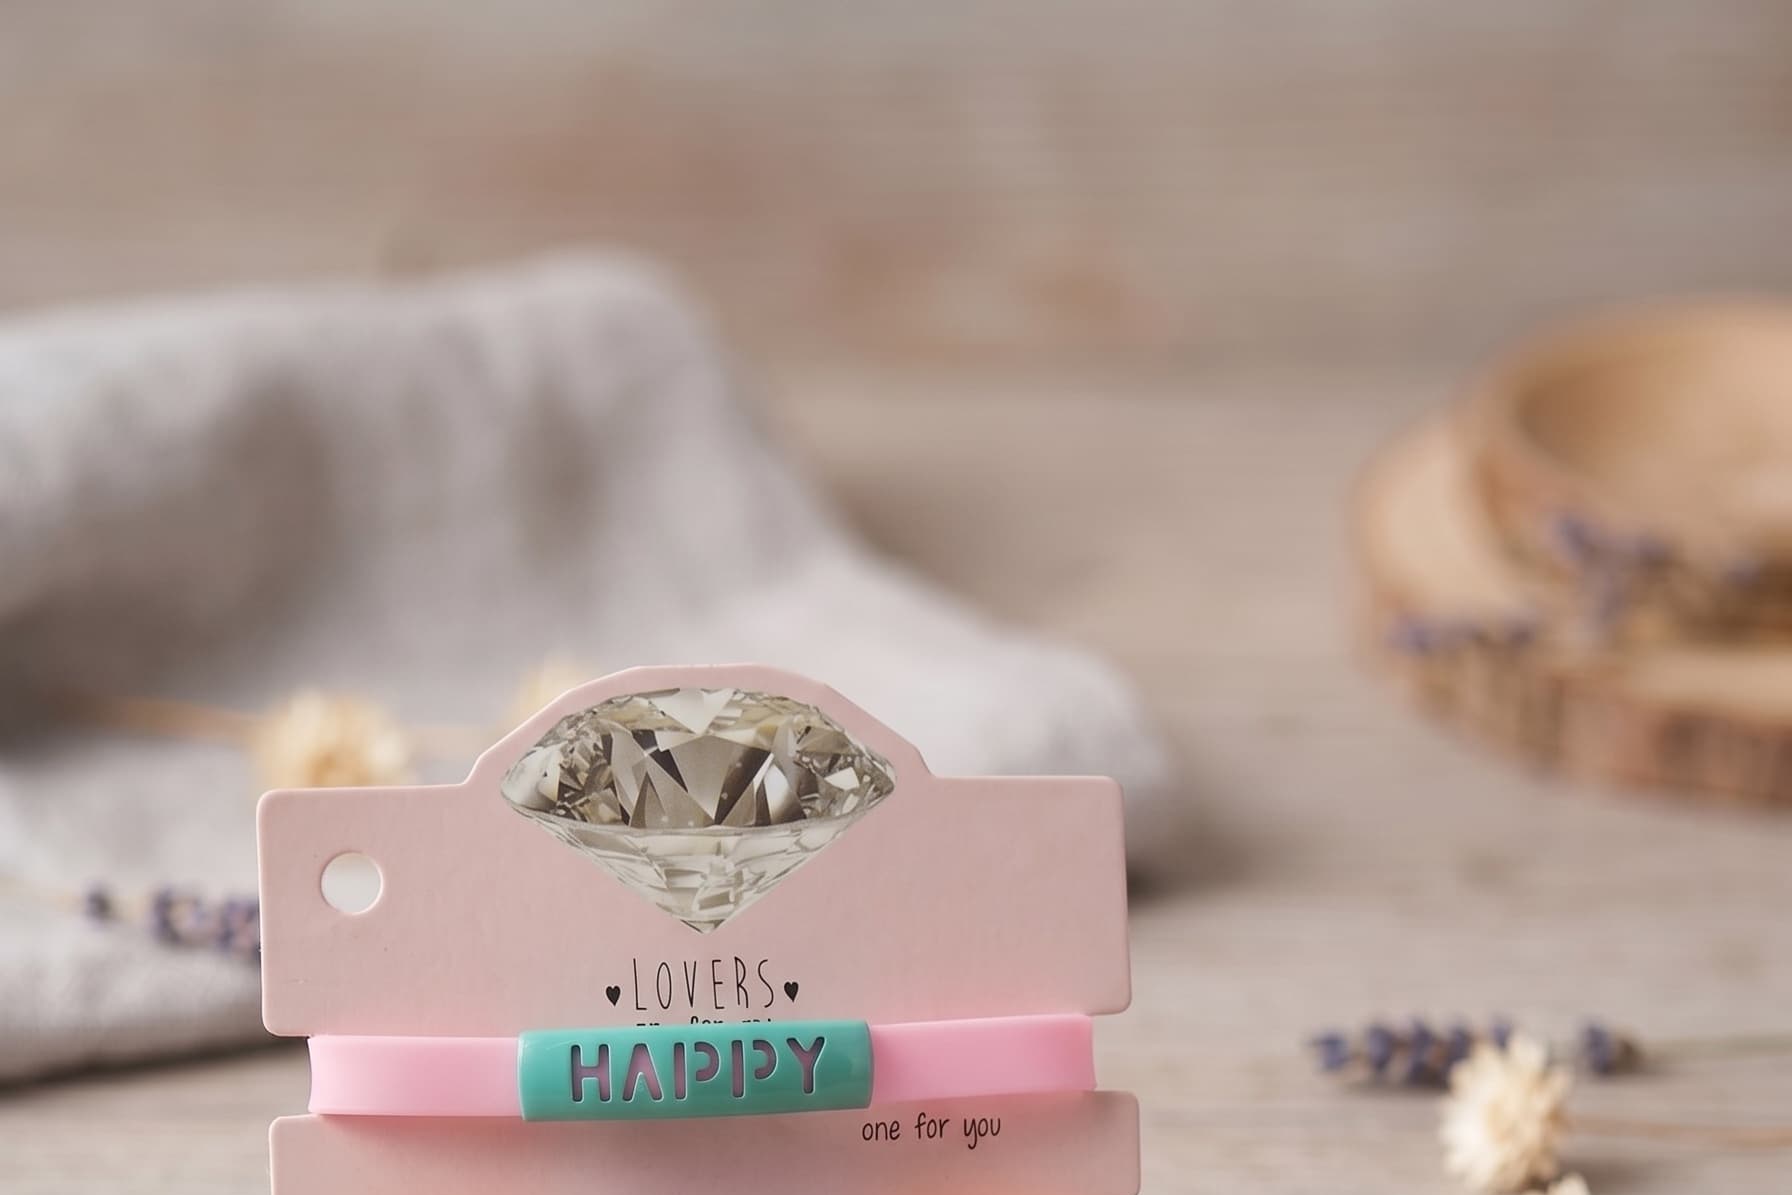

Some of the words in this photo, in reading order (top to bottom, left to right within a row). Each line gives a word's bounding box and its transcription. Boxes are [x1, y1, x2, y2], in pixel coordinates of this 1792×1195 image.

[632, 956, 775, 1011] LOVERS
[570, 1036, 826, 1103] HAPPY
[861, 1120, 901, 1141] one
[914, 1111, 950, 1140] for
[963, 1117, 1001, 1150] you
